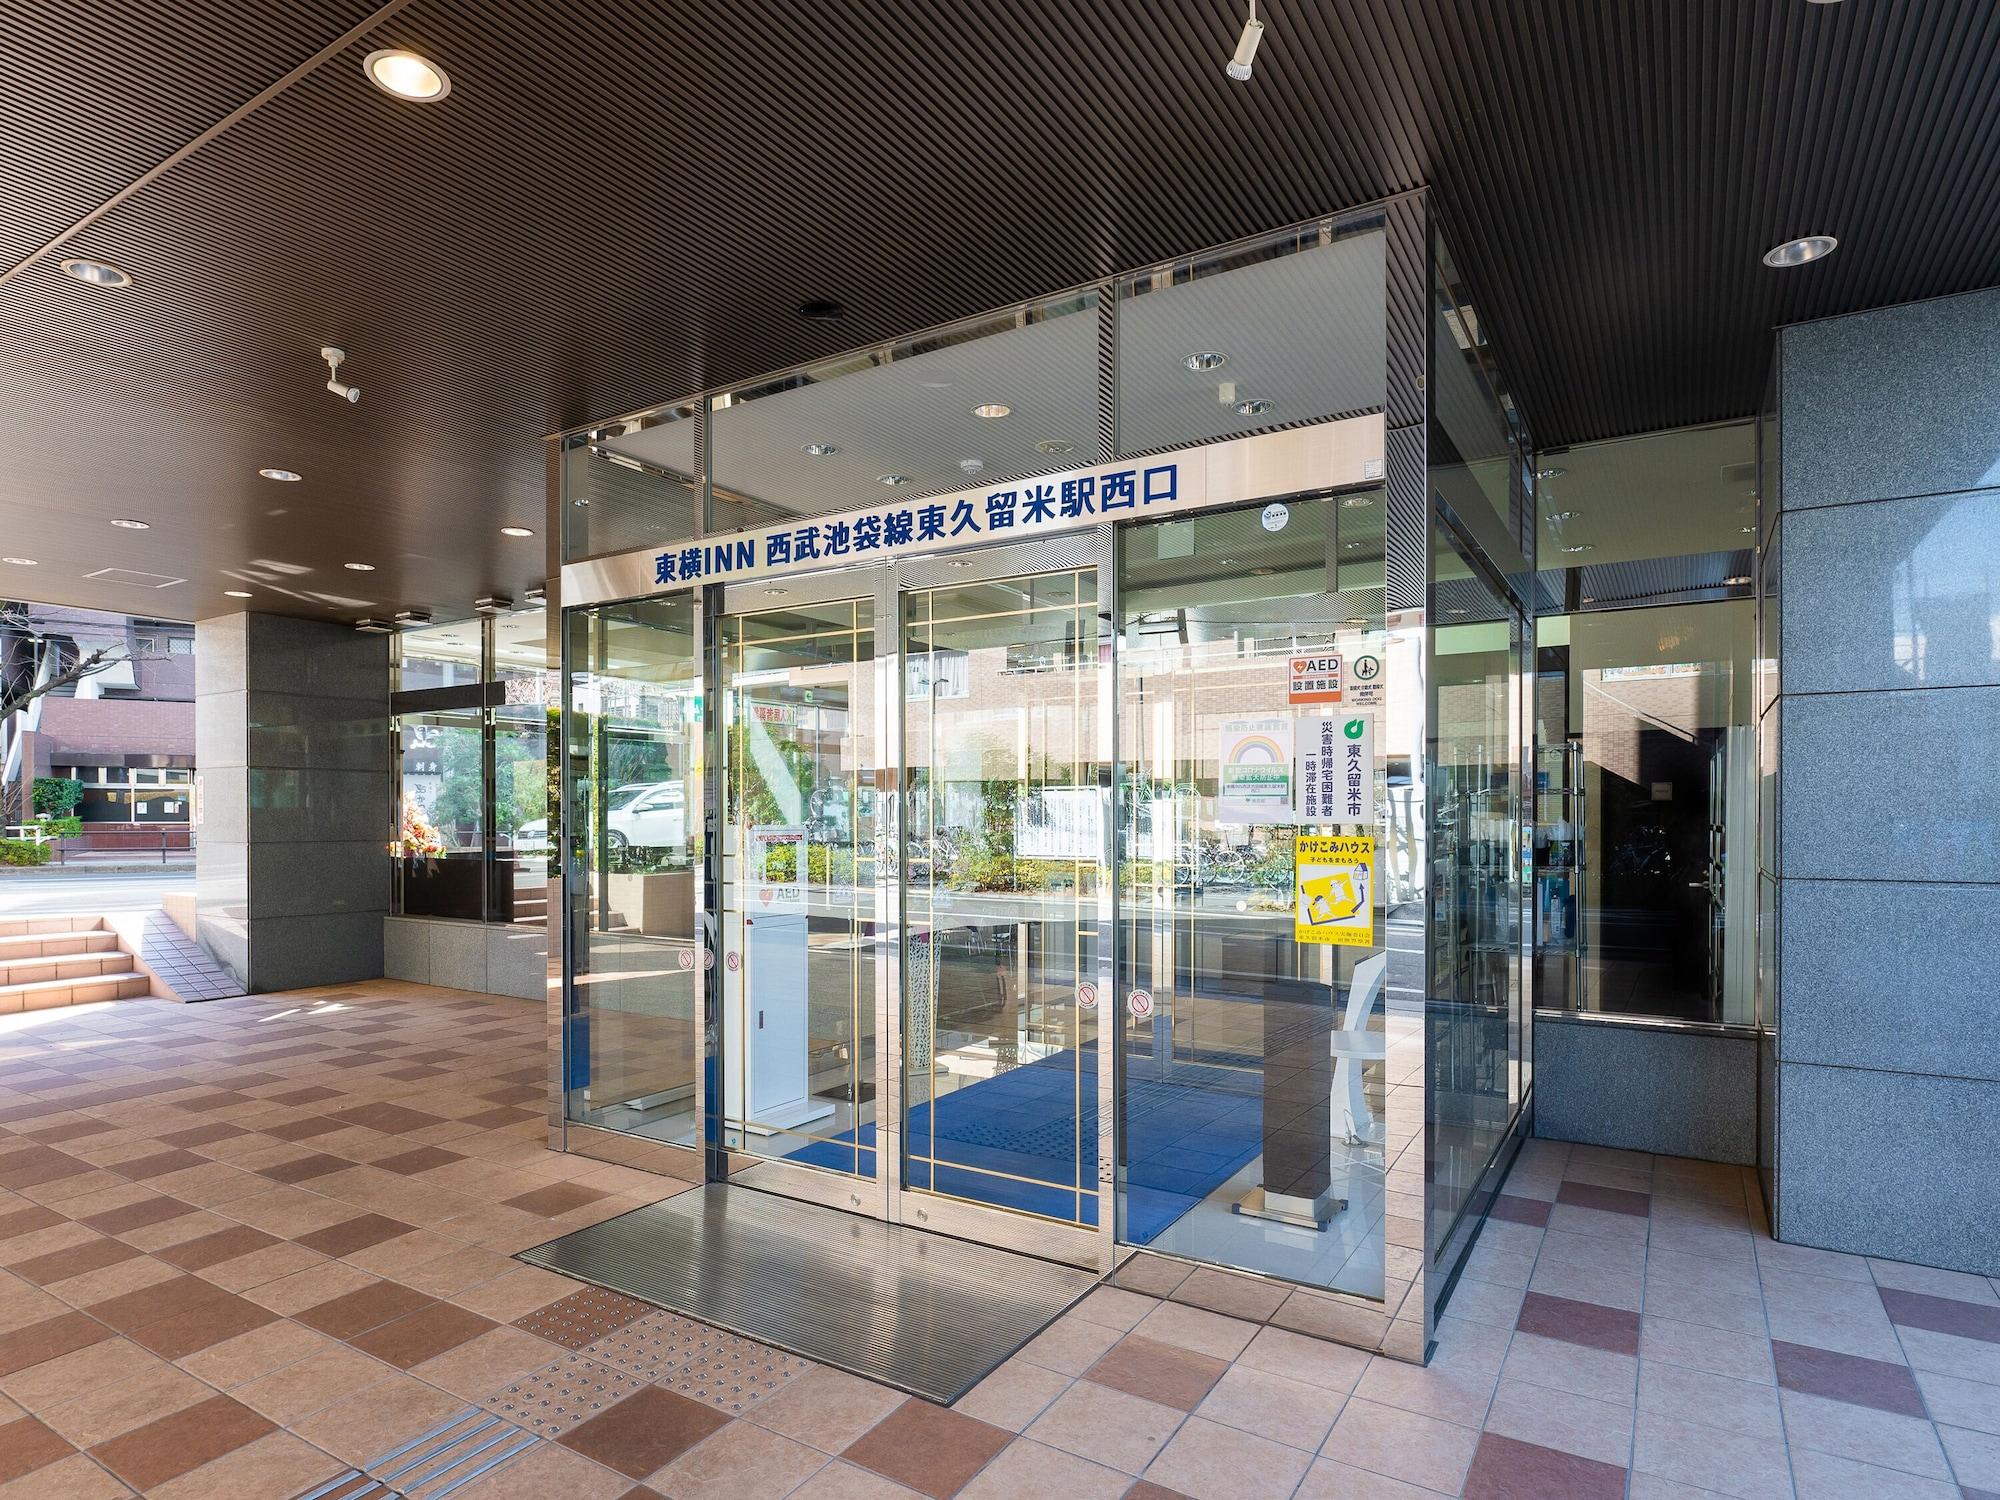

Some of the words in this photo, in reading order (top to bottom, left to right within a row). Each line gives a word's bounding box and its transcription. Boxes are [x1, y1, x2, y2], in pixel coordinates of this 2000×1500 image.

[654, 539, 755, 585] 東横INN
[766, 464, 1178, 563] 西武池袋線東久留米駅西口
[1306, 659, 1339, 671] AED
[1293, 679, 1339, 691] 設置施設
[1305, 753, 1317, 817] 一時滞在施設
[1321, 721, 1334, 817] 災害時帰宅困難者
[1346, 743, 1362, 817] 東久留米市
[1299, 841, 1370, 855] かけこみハウス
[777, 888, 800, 899] AED
